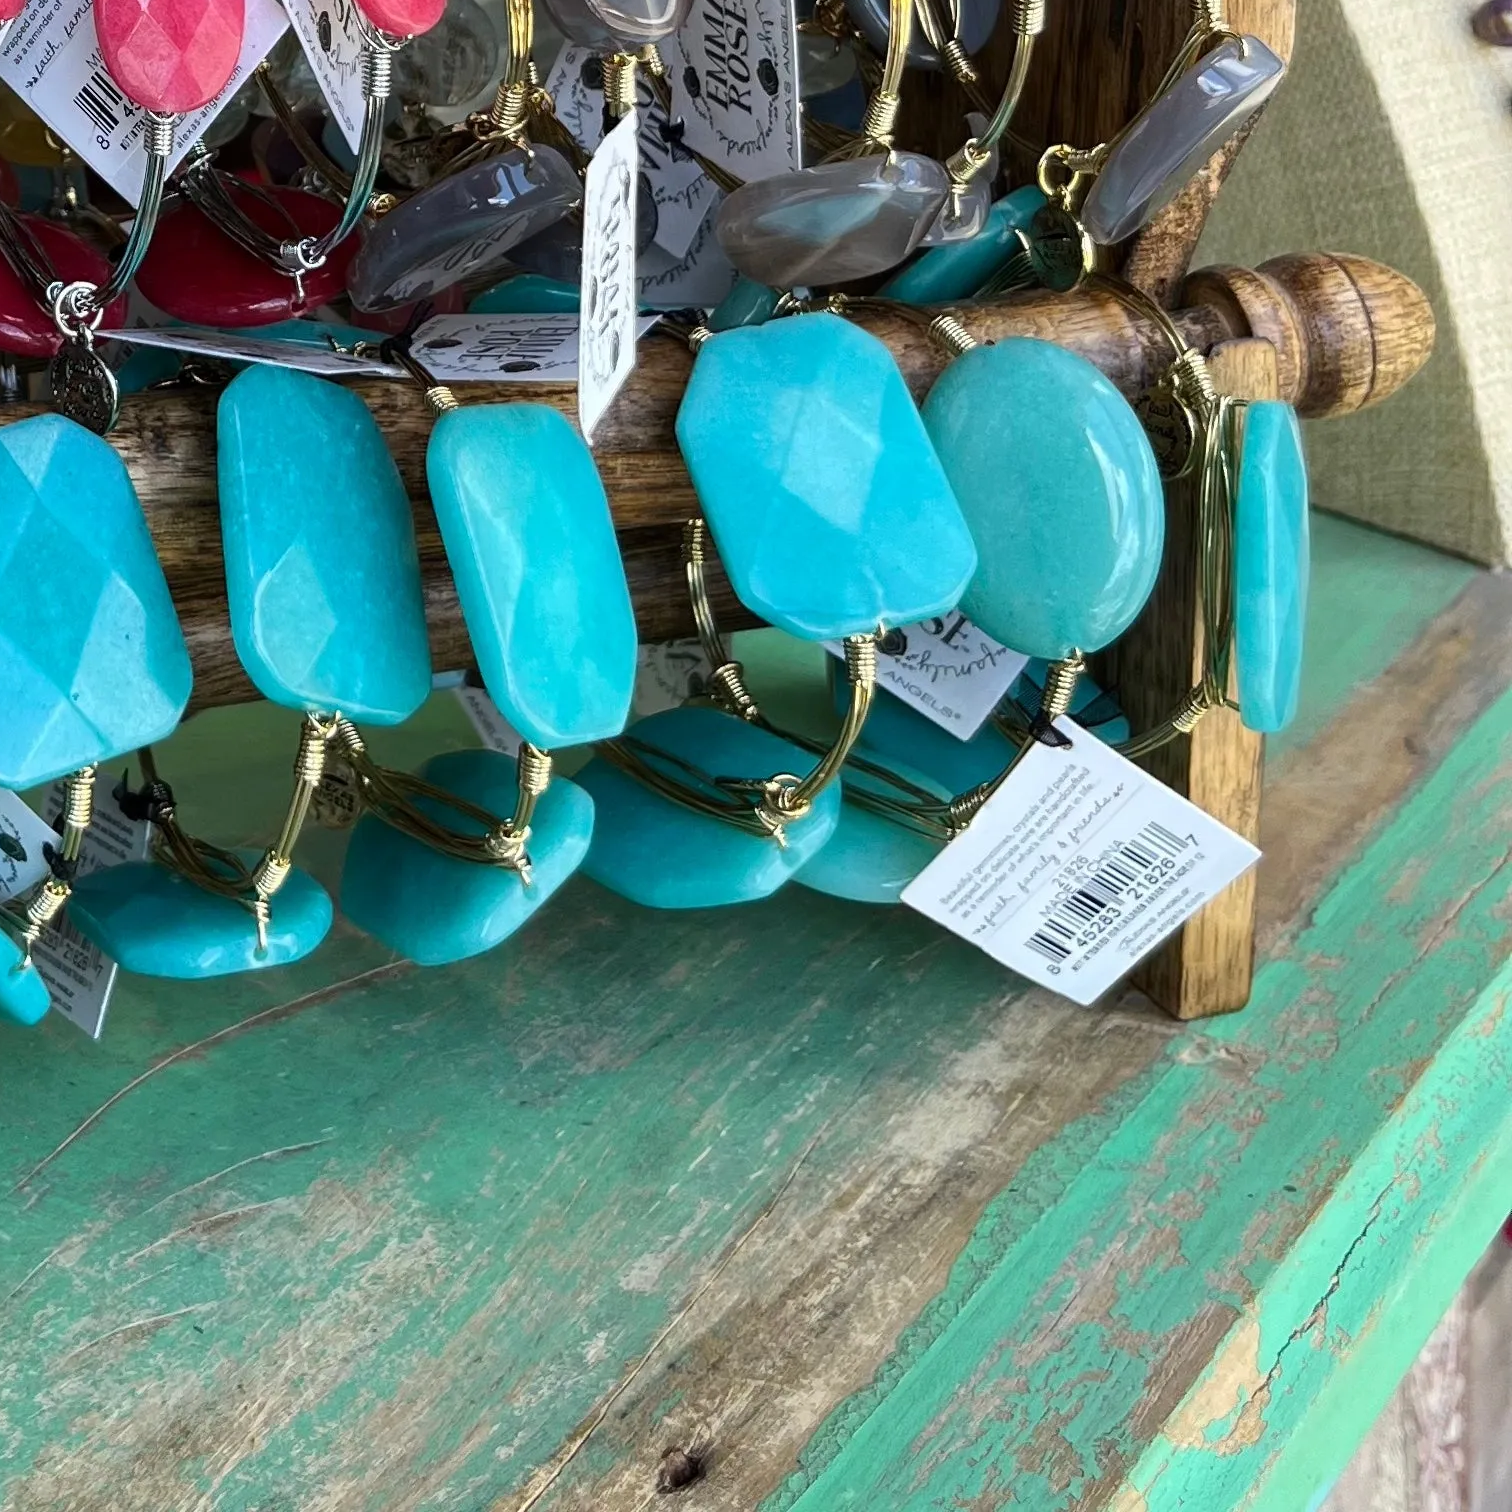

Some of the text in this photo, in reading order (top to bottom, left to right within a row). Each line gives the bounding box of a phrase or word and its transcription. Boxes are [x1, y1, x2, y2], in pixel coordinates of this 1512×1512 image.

[12, 52, 24, 65] as
[22, 6, 56, 48] reminder
[27, 6, 40, 21] on
[93, 133, 112, 151] 8
[880, 667, 955, 719] ANGELS
[1037, 834, 1125, 919] MADE IN CHINA
[1045, 832, 1199, 977] 8 45283 21826 7
